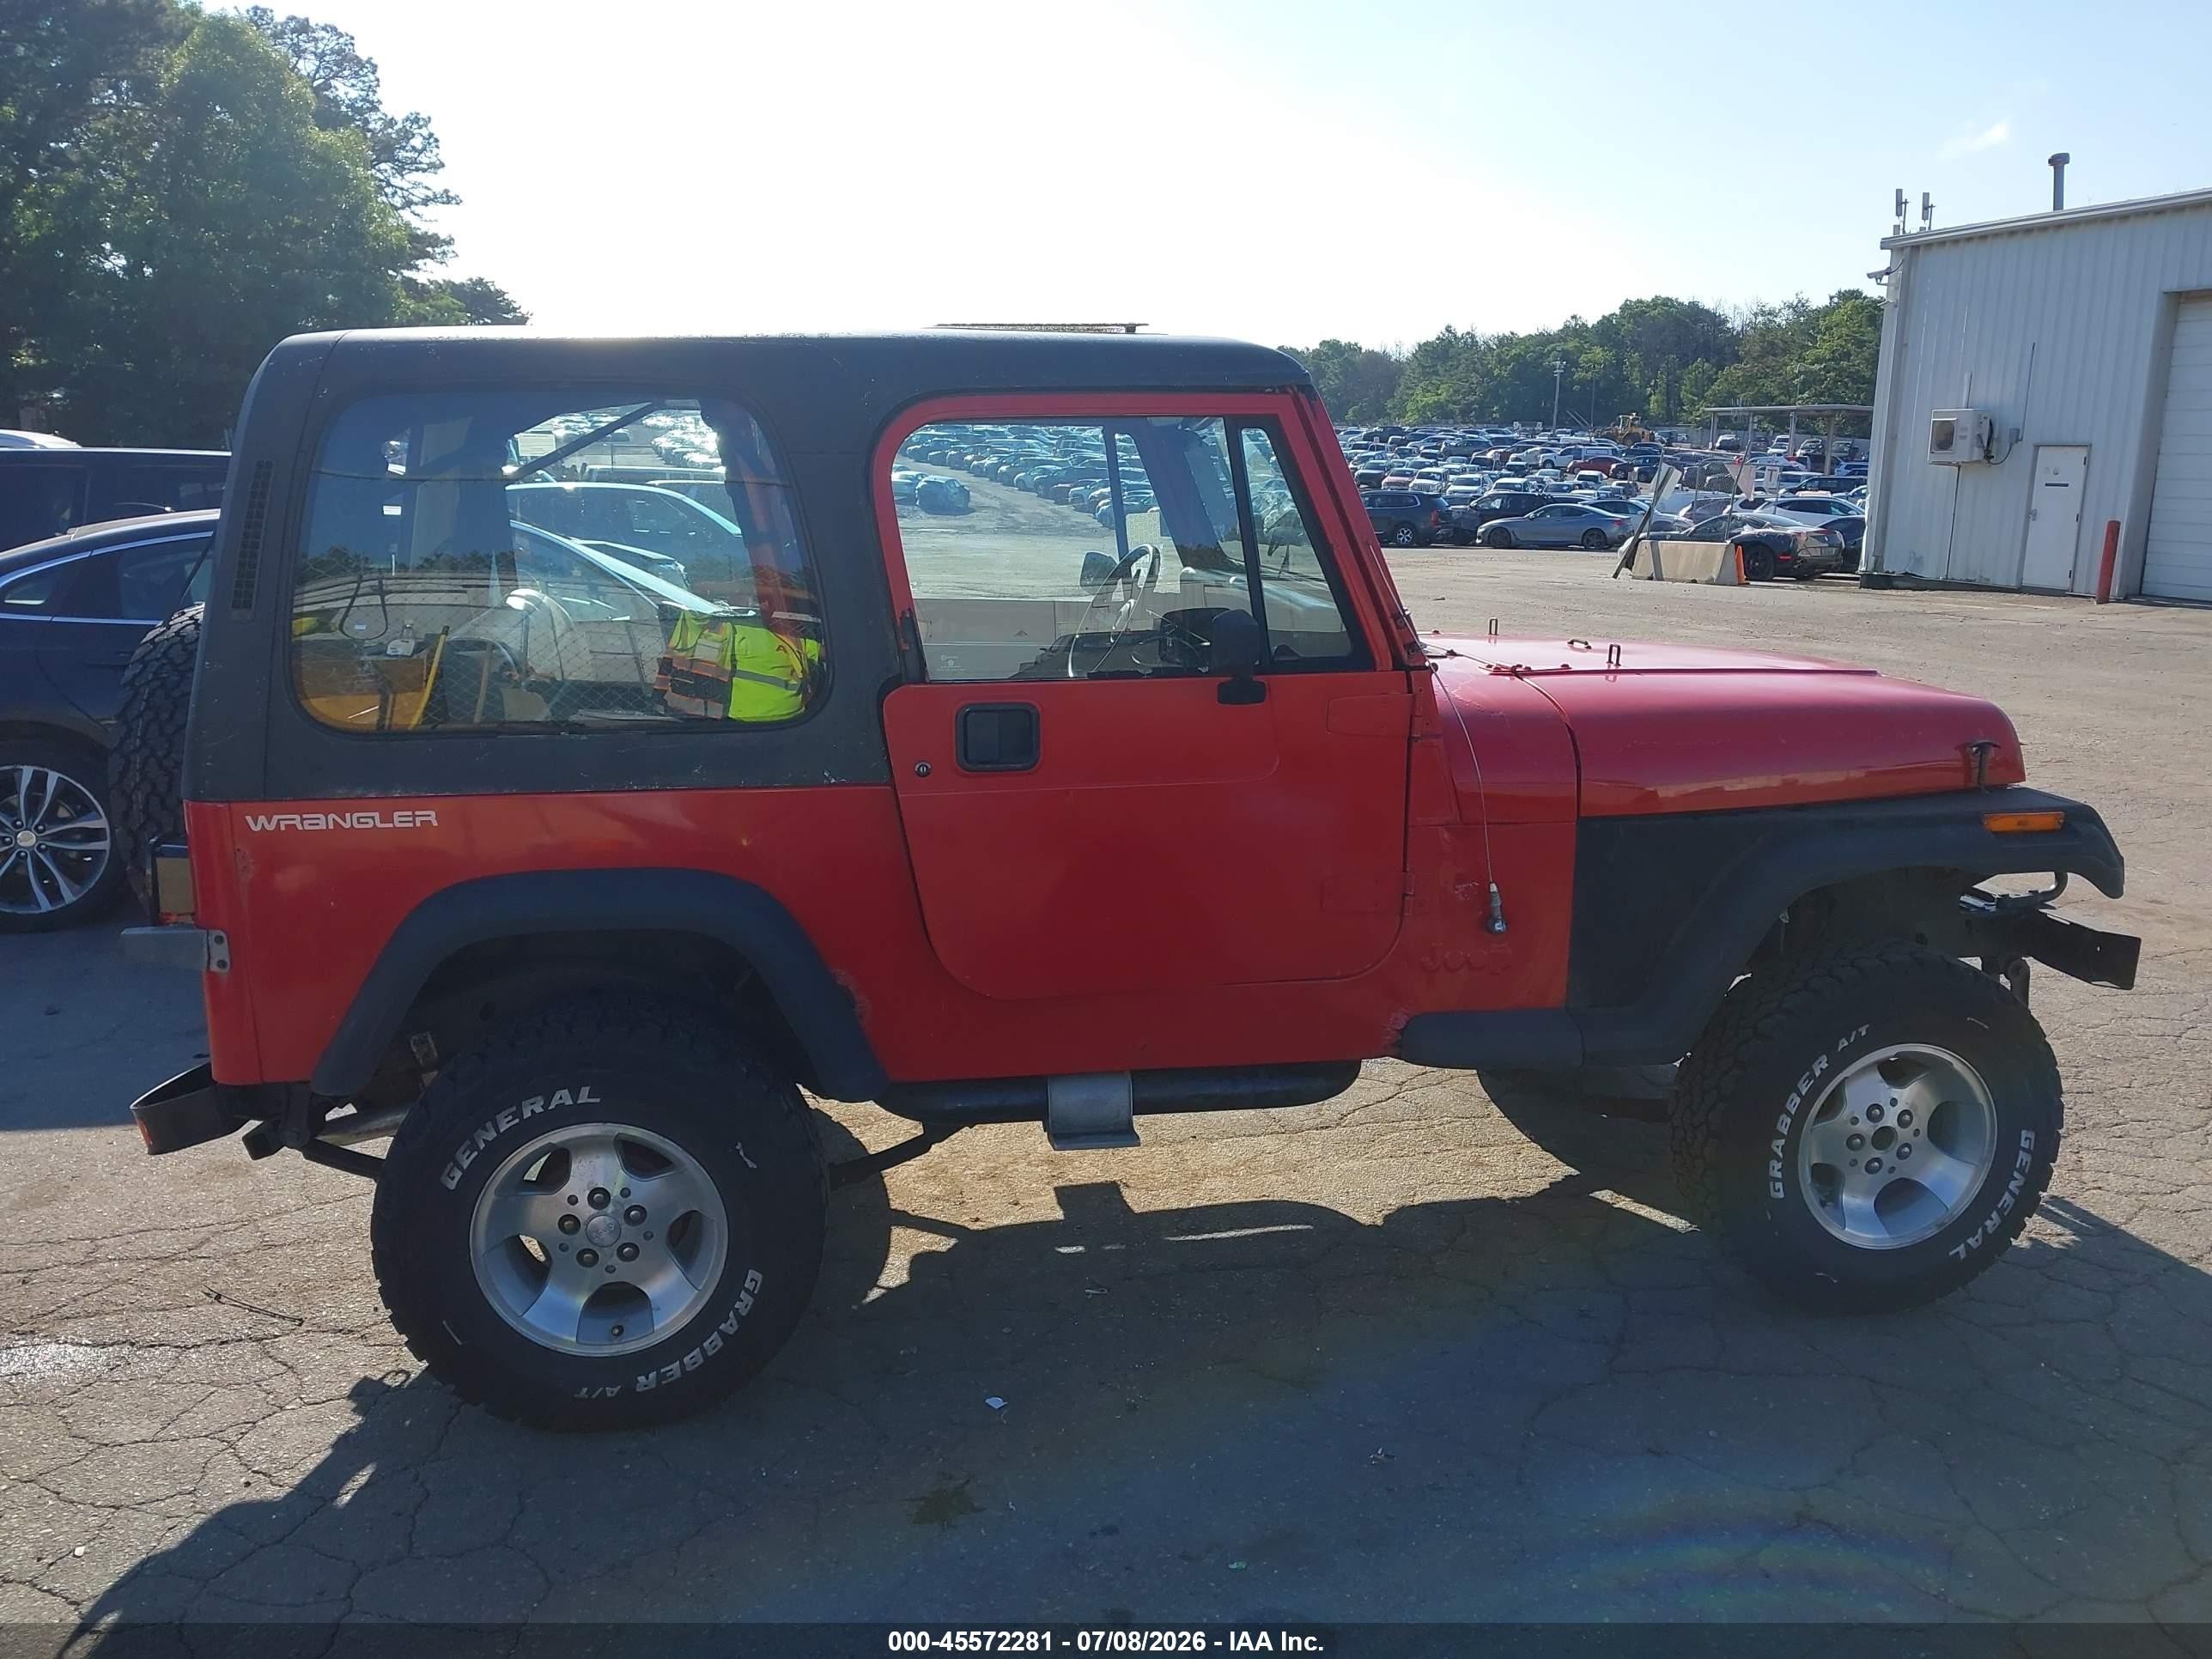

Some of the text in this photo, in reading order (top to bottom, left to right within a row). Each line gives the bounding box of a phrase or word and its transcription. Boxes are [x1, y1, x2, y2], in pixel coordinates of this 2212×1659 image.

[440, 1085, 601, 1190] GENERAL
[1769, 1024, 1870, 1199] GRABBER A/T
[1948, 1129, 2035, 1261] GENERAL
[574, 1268, 763, 1399] GRABBER A/T
